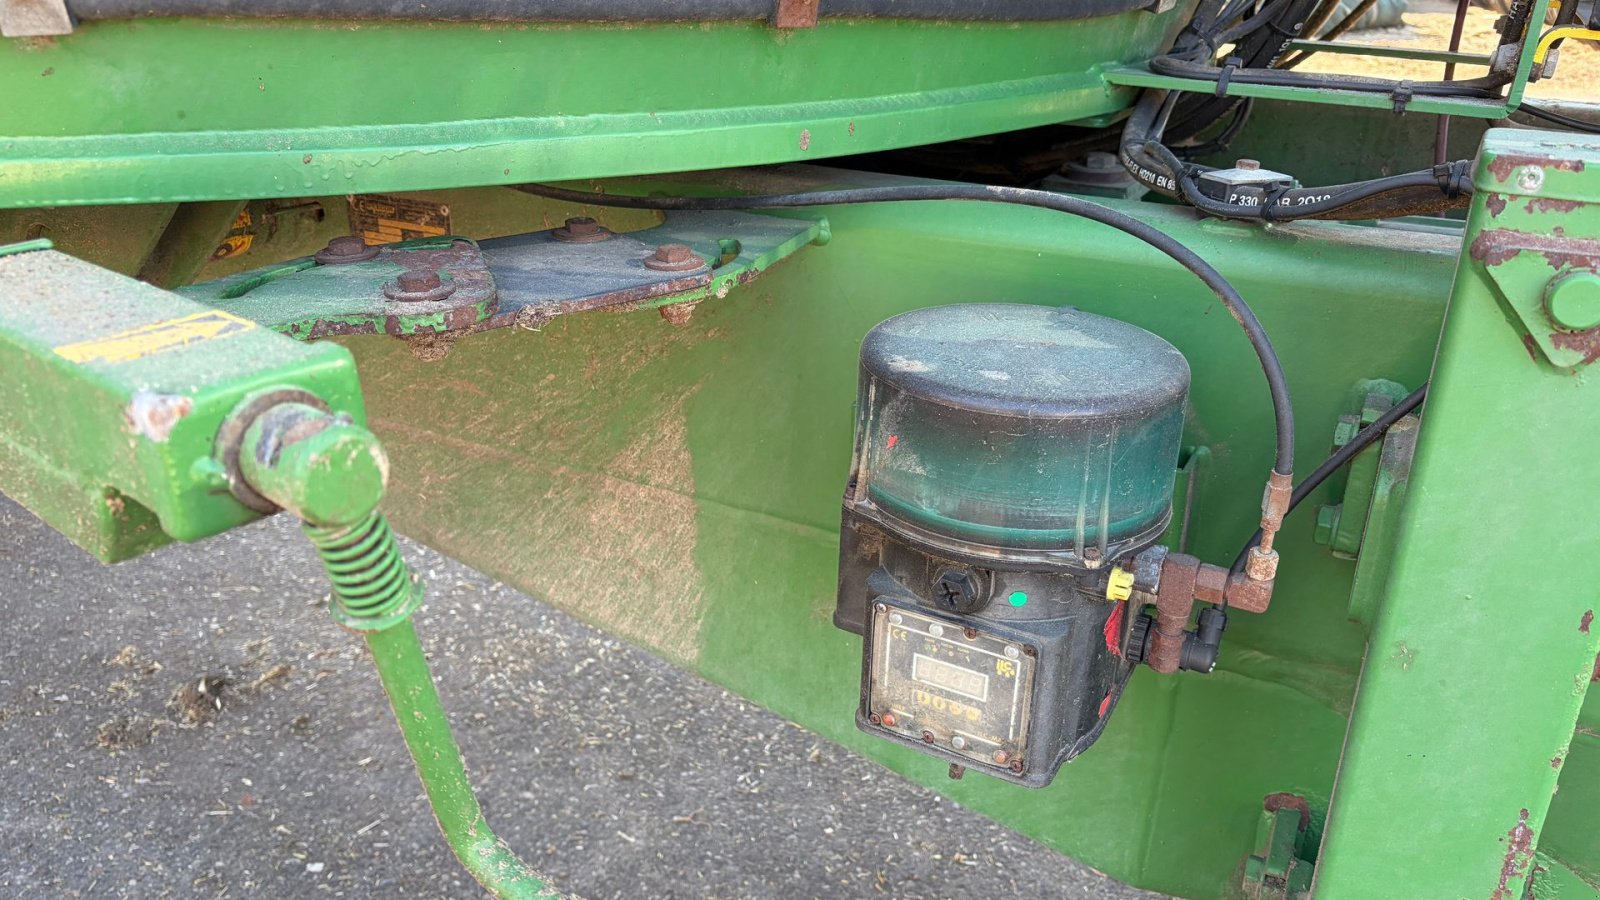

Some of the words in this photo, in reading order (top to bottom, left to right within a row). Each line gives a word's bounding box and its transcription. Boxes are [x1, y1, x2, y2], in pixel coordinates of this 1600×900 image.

[1157, 175, 1168, 188] EN
[1229, 193, 1238, 204] P
[1238, 194, 1258, 207] 330
